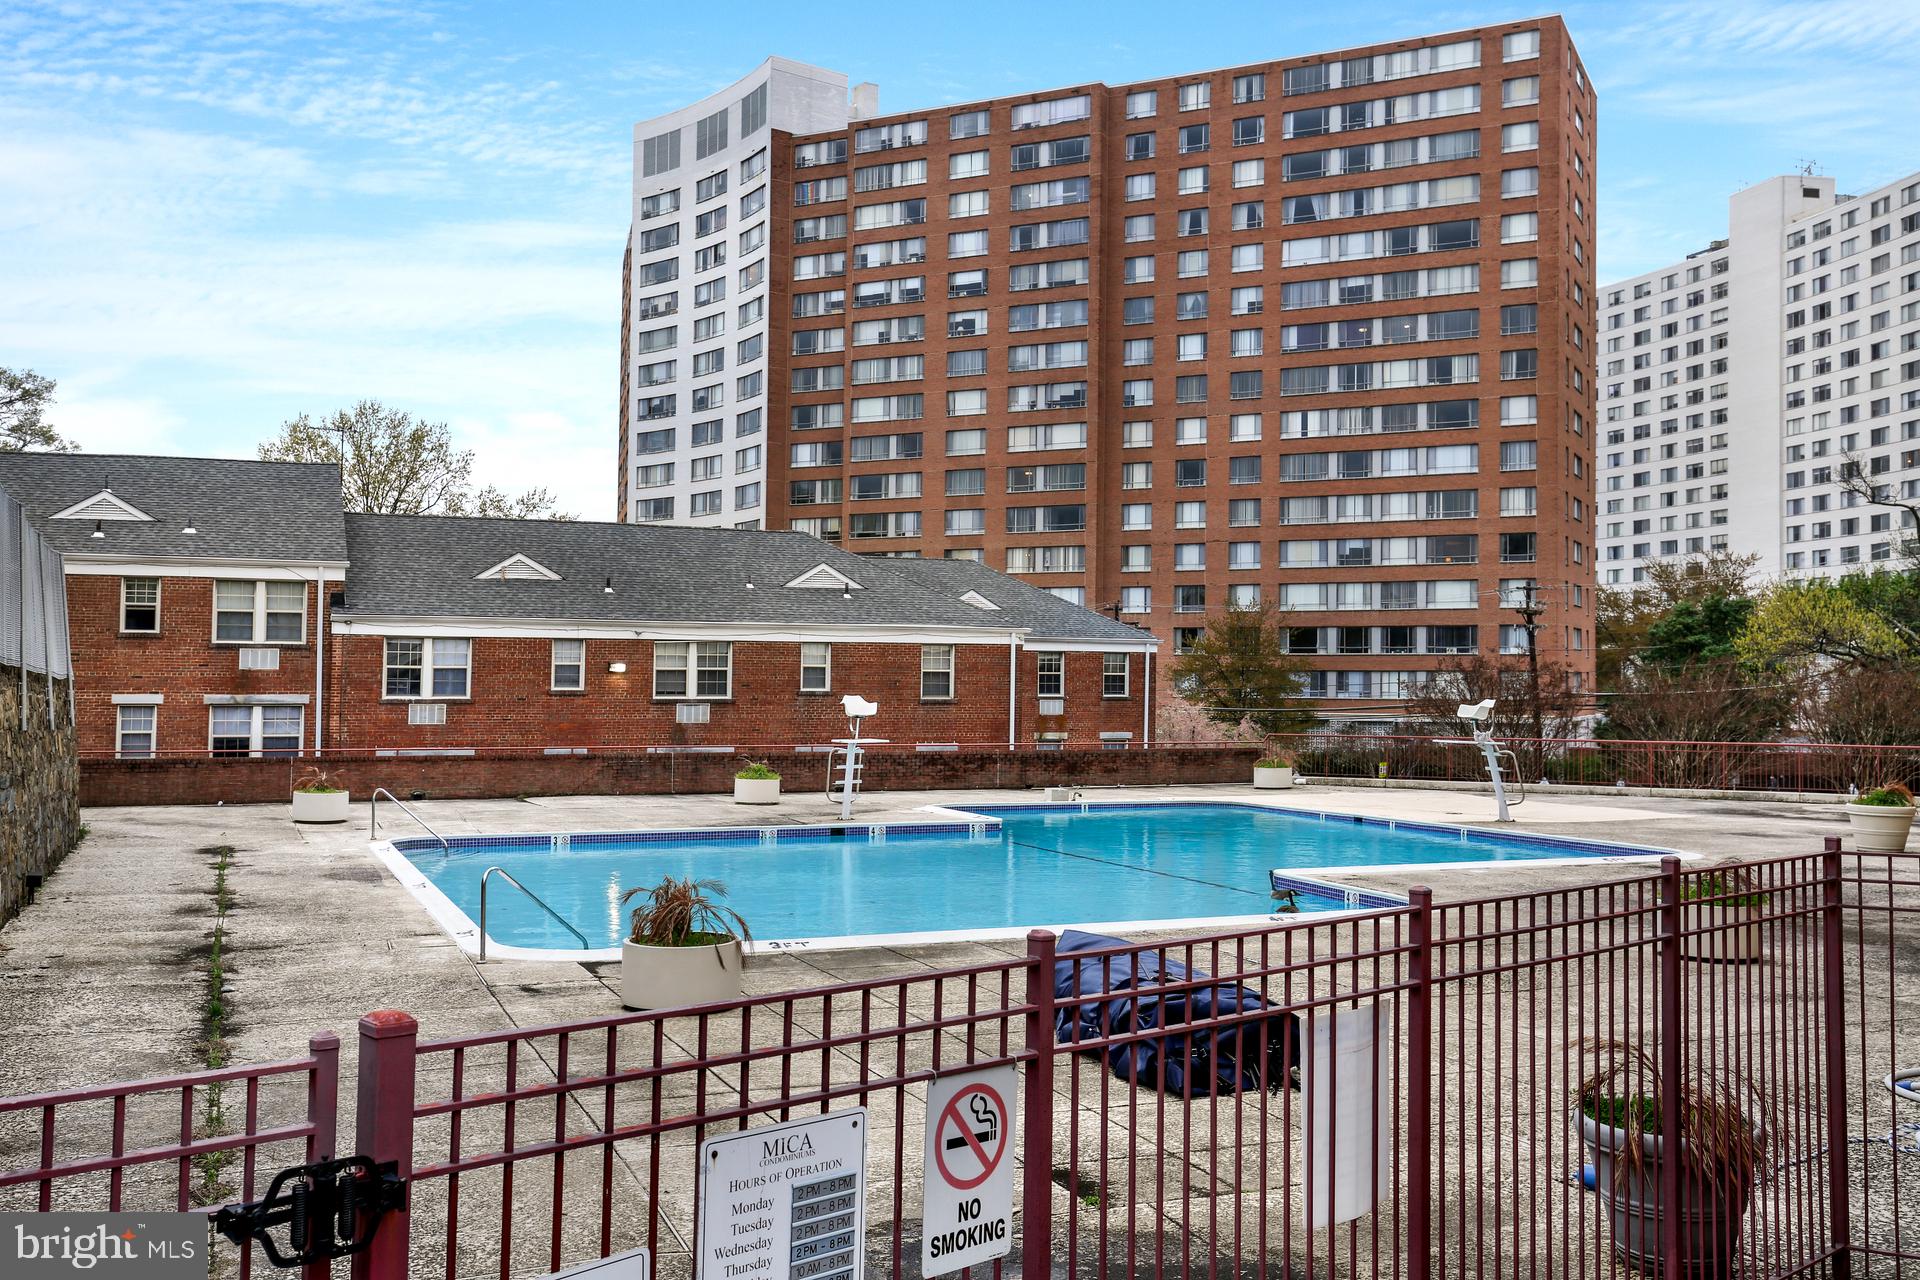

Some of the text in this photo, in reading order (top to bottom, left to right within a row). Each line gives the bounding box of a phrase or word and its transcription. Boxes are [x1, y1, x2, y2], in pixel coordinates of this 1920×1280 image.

[759, 1150, 816, 1167] CONDOMINIUMS
[763, 1132, 813, 1159] MICA
[731, 1197, 775, 1216] Monday
[798, 1189, 803, 1199] 2
[806, 1184, 820, 1197] PM
[830, 1181, 835, 1191] 8
[837, 1177, 852, 1189] PM
[731, 1216, 774, 1236] Tuesday
[797, 1209, 803, 1219] 2
[805, 1203, 819, 1217] PM
[829, 1201, 835, 1211] 8
[837, 1196, 851, 1209] PM
[958, 1198, 981, 1223] NO
[714, 1237, 774, 1260] Wednesday
[797, 1228, 802, 1239] 2
[804, 1223, 819, 1237] PM
[828, 1220, 834, 1231] 8
[836, 1216, 850, 1228] PM
[724, 1257, 773, 1278] Thursday
[796, 1247, 801, 1257] 2
[803, 1244, 818, 1256] PM
[829, 1238, 835, 1248] 8
[836, 1235, 850, 1247] PM
[930, 1218, 1005, 1258] SMOKING
[796, 1265, 805, 1277] 10
[807, 1262, 820, 1275] AM
[829, 1258, 835, 1268] 8
[836, 1254, 850, 1266] PM
